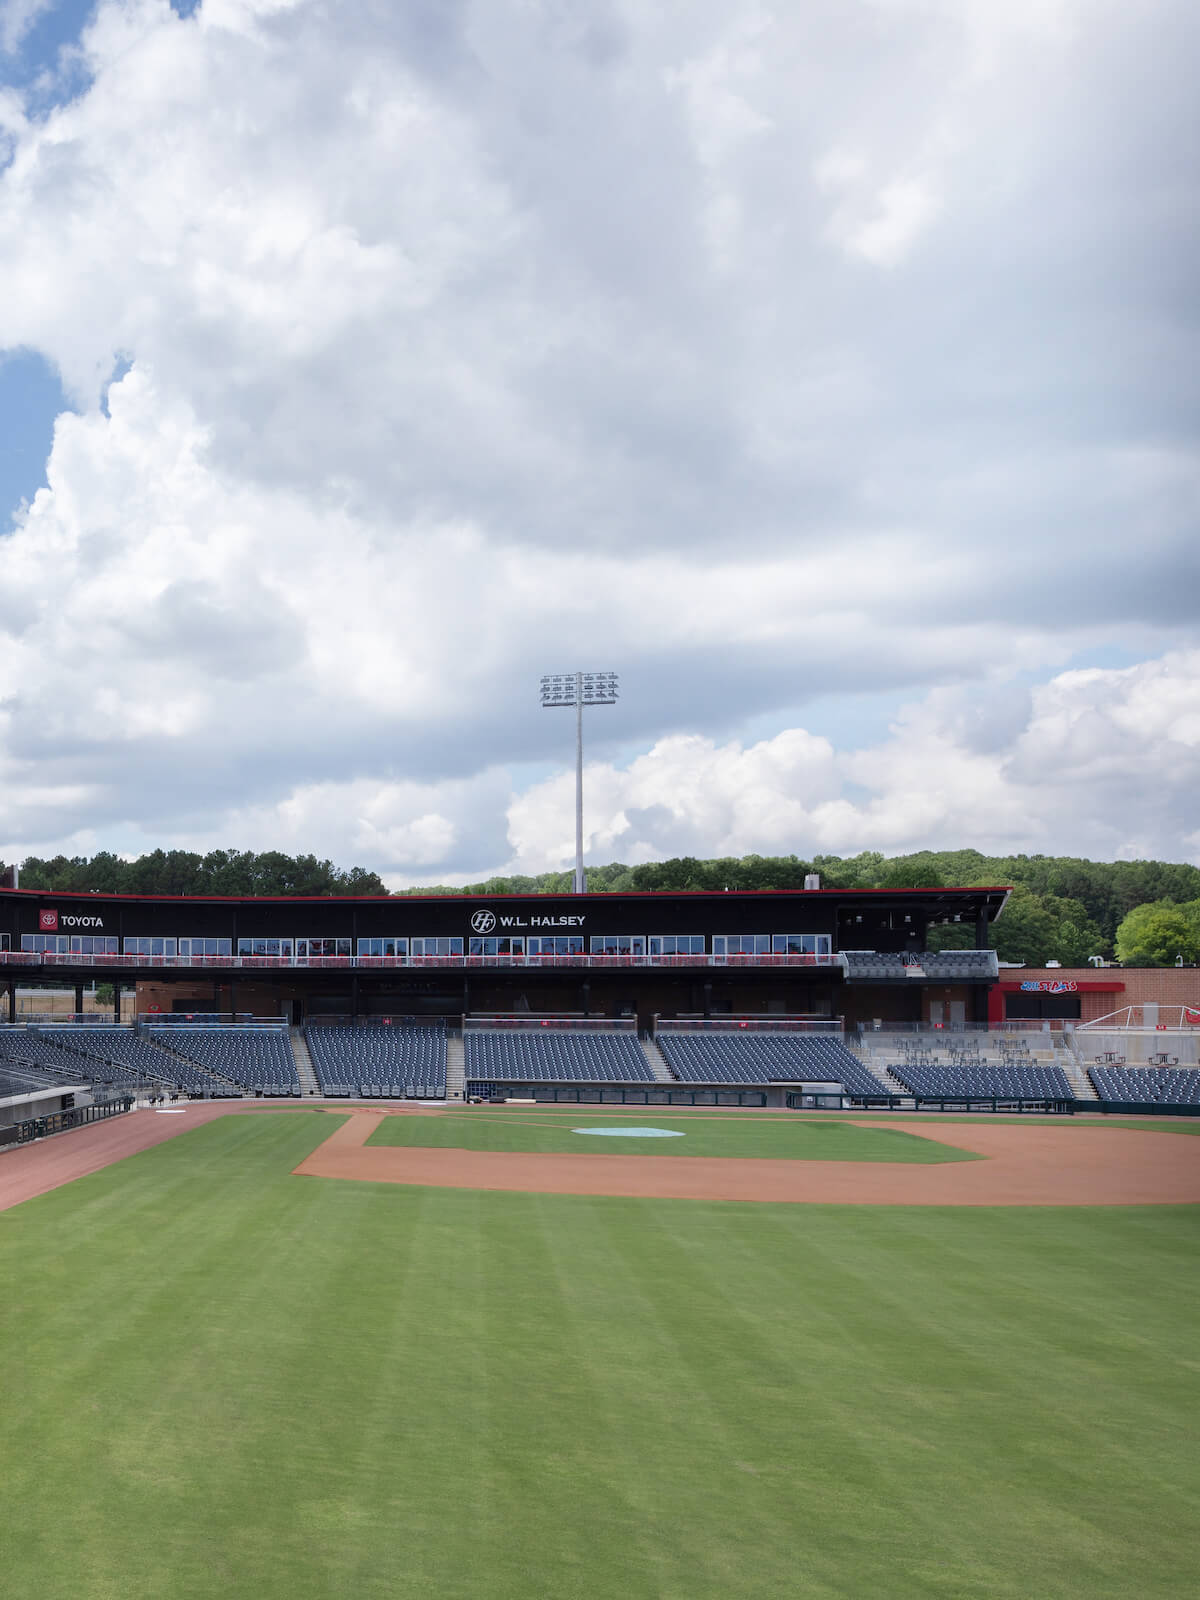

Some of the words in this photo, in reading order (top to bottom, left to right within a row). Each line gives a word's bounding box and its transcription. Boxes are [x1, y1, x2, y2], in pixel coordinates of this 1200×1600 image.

[61, 915, 104, 928] TOYOTA
[500, 916, 528, 927] W.L.
[531, 916, 586, 926] HALSEY
